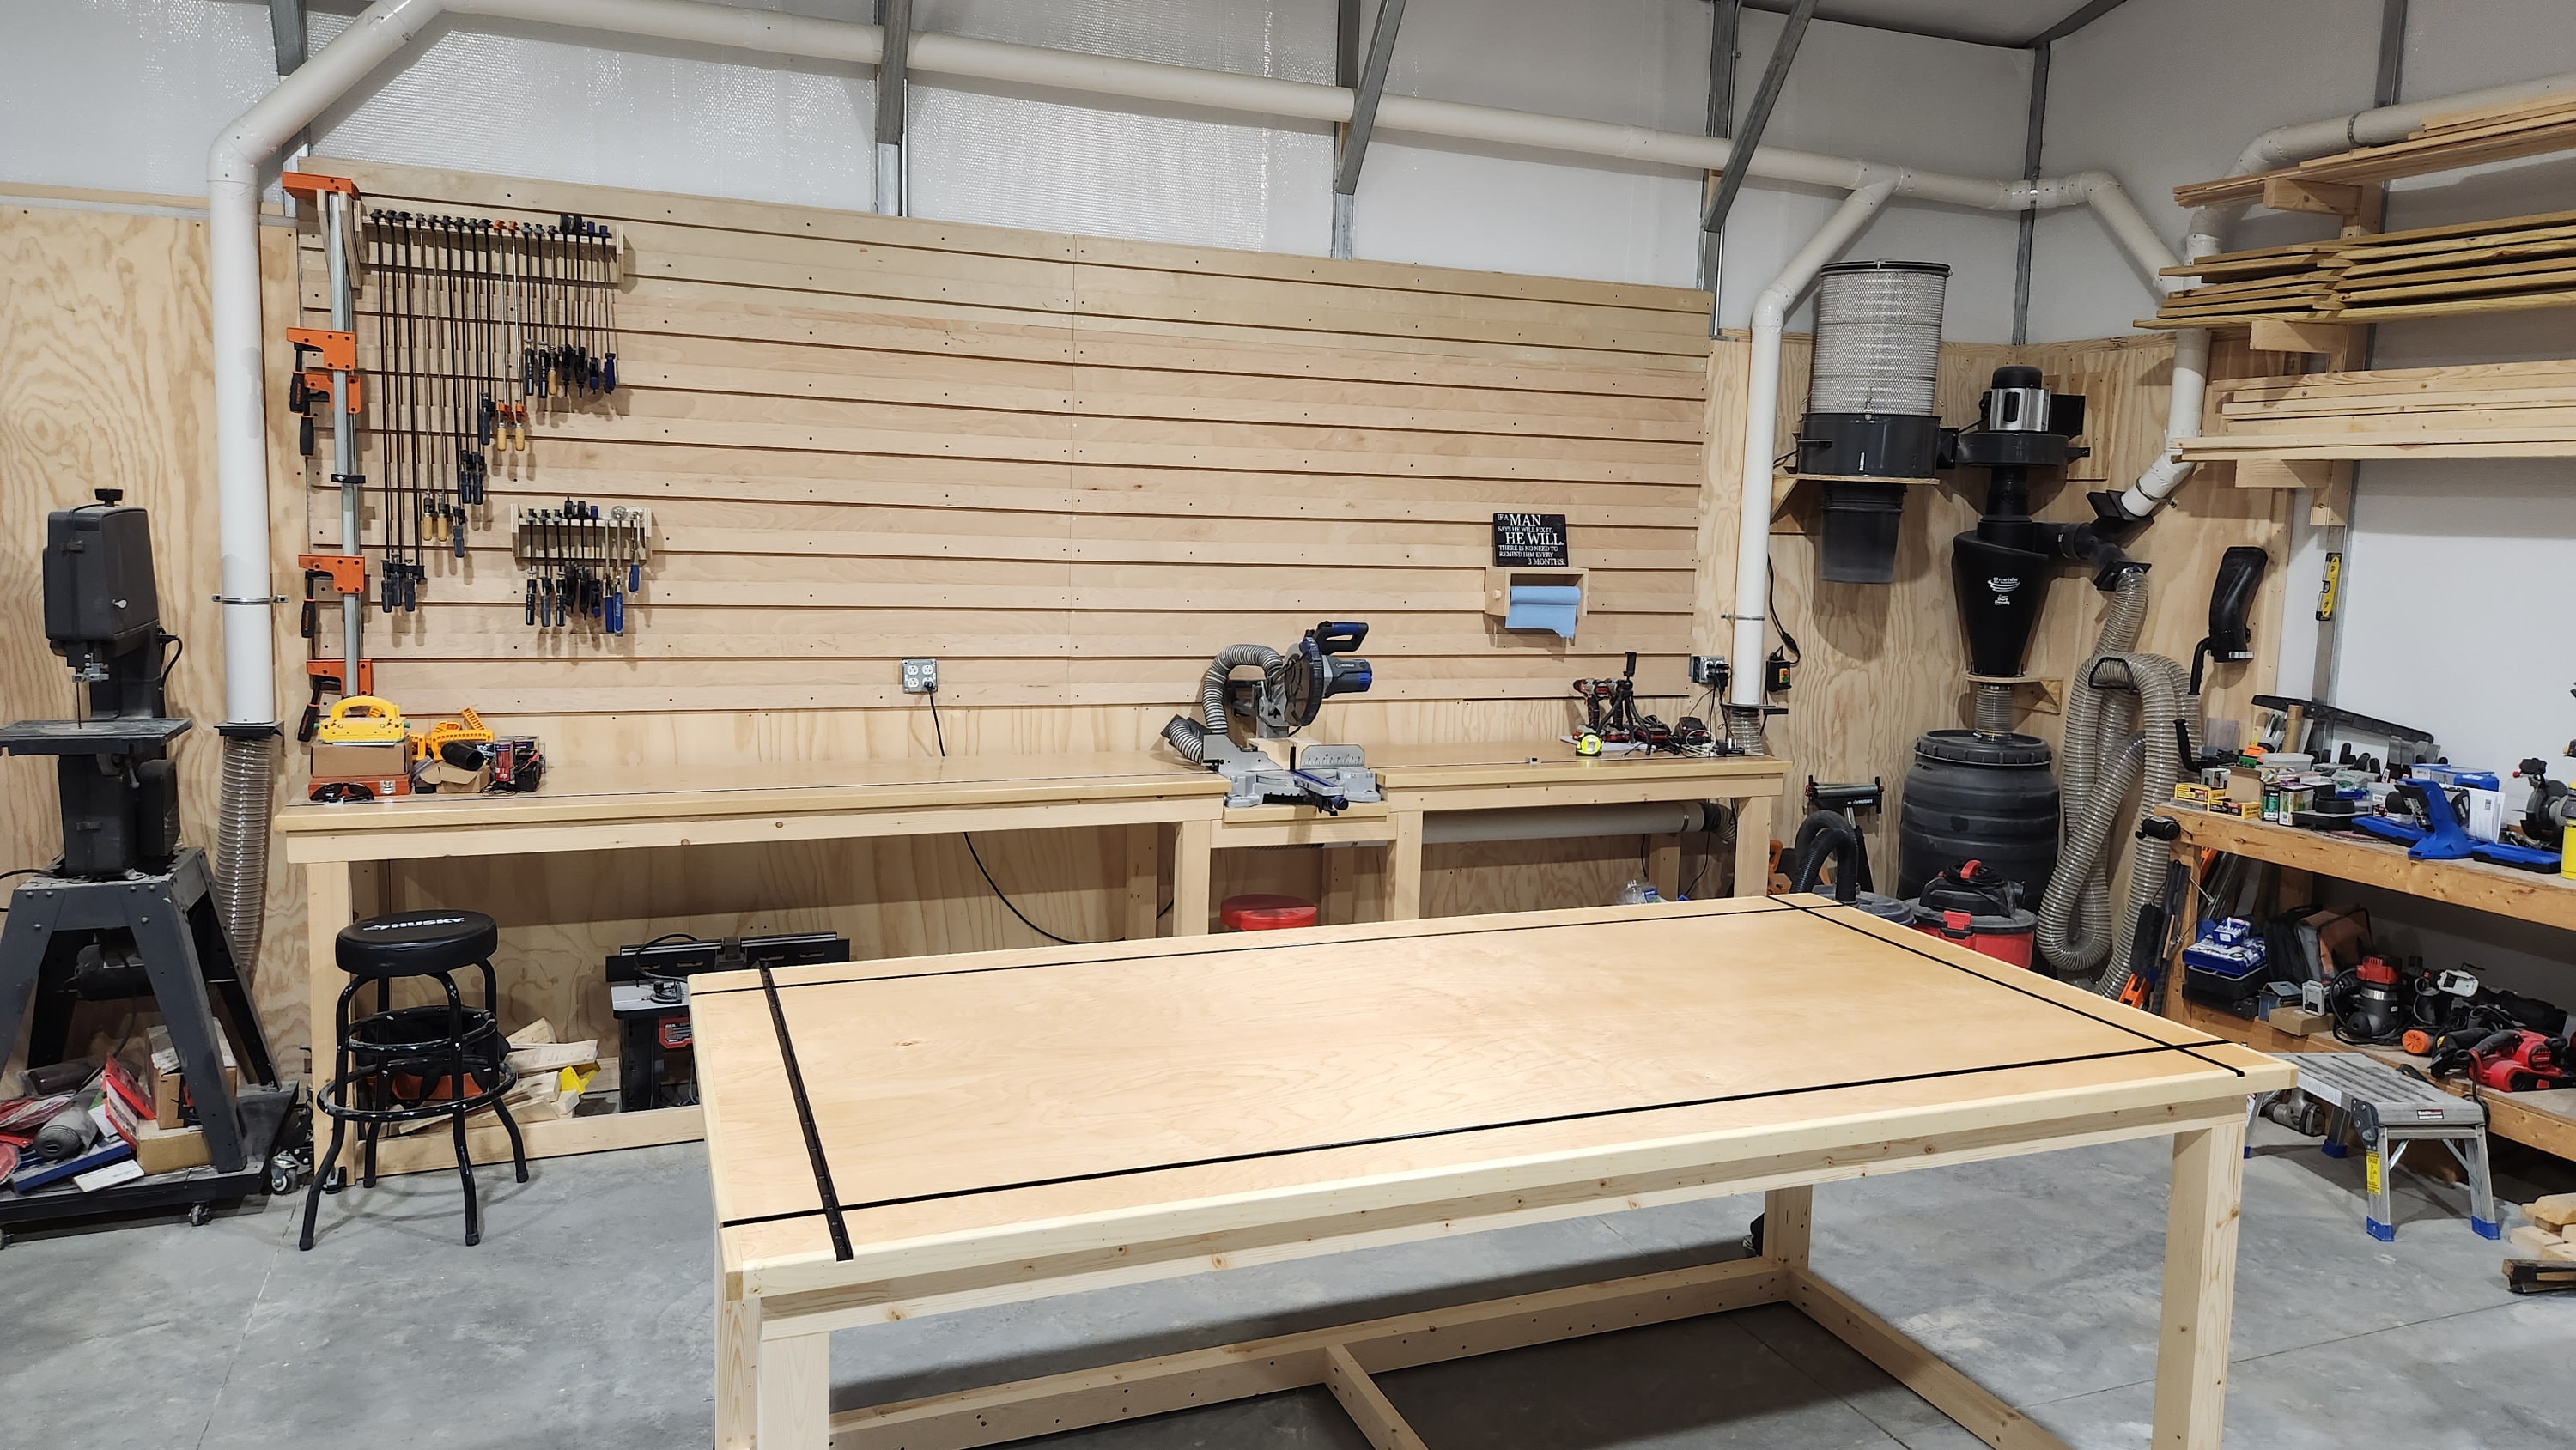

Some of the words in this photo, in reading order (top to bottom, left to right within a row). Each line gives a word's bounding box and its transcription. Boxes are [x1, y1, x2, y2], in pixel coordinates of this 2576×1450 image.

[1509, 514, 1541, 526] MAN
[1506, 532, 1525, 545] HE
[391, 917, 464, 928] HUSKY
